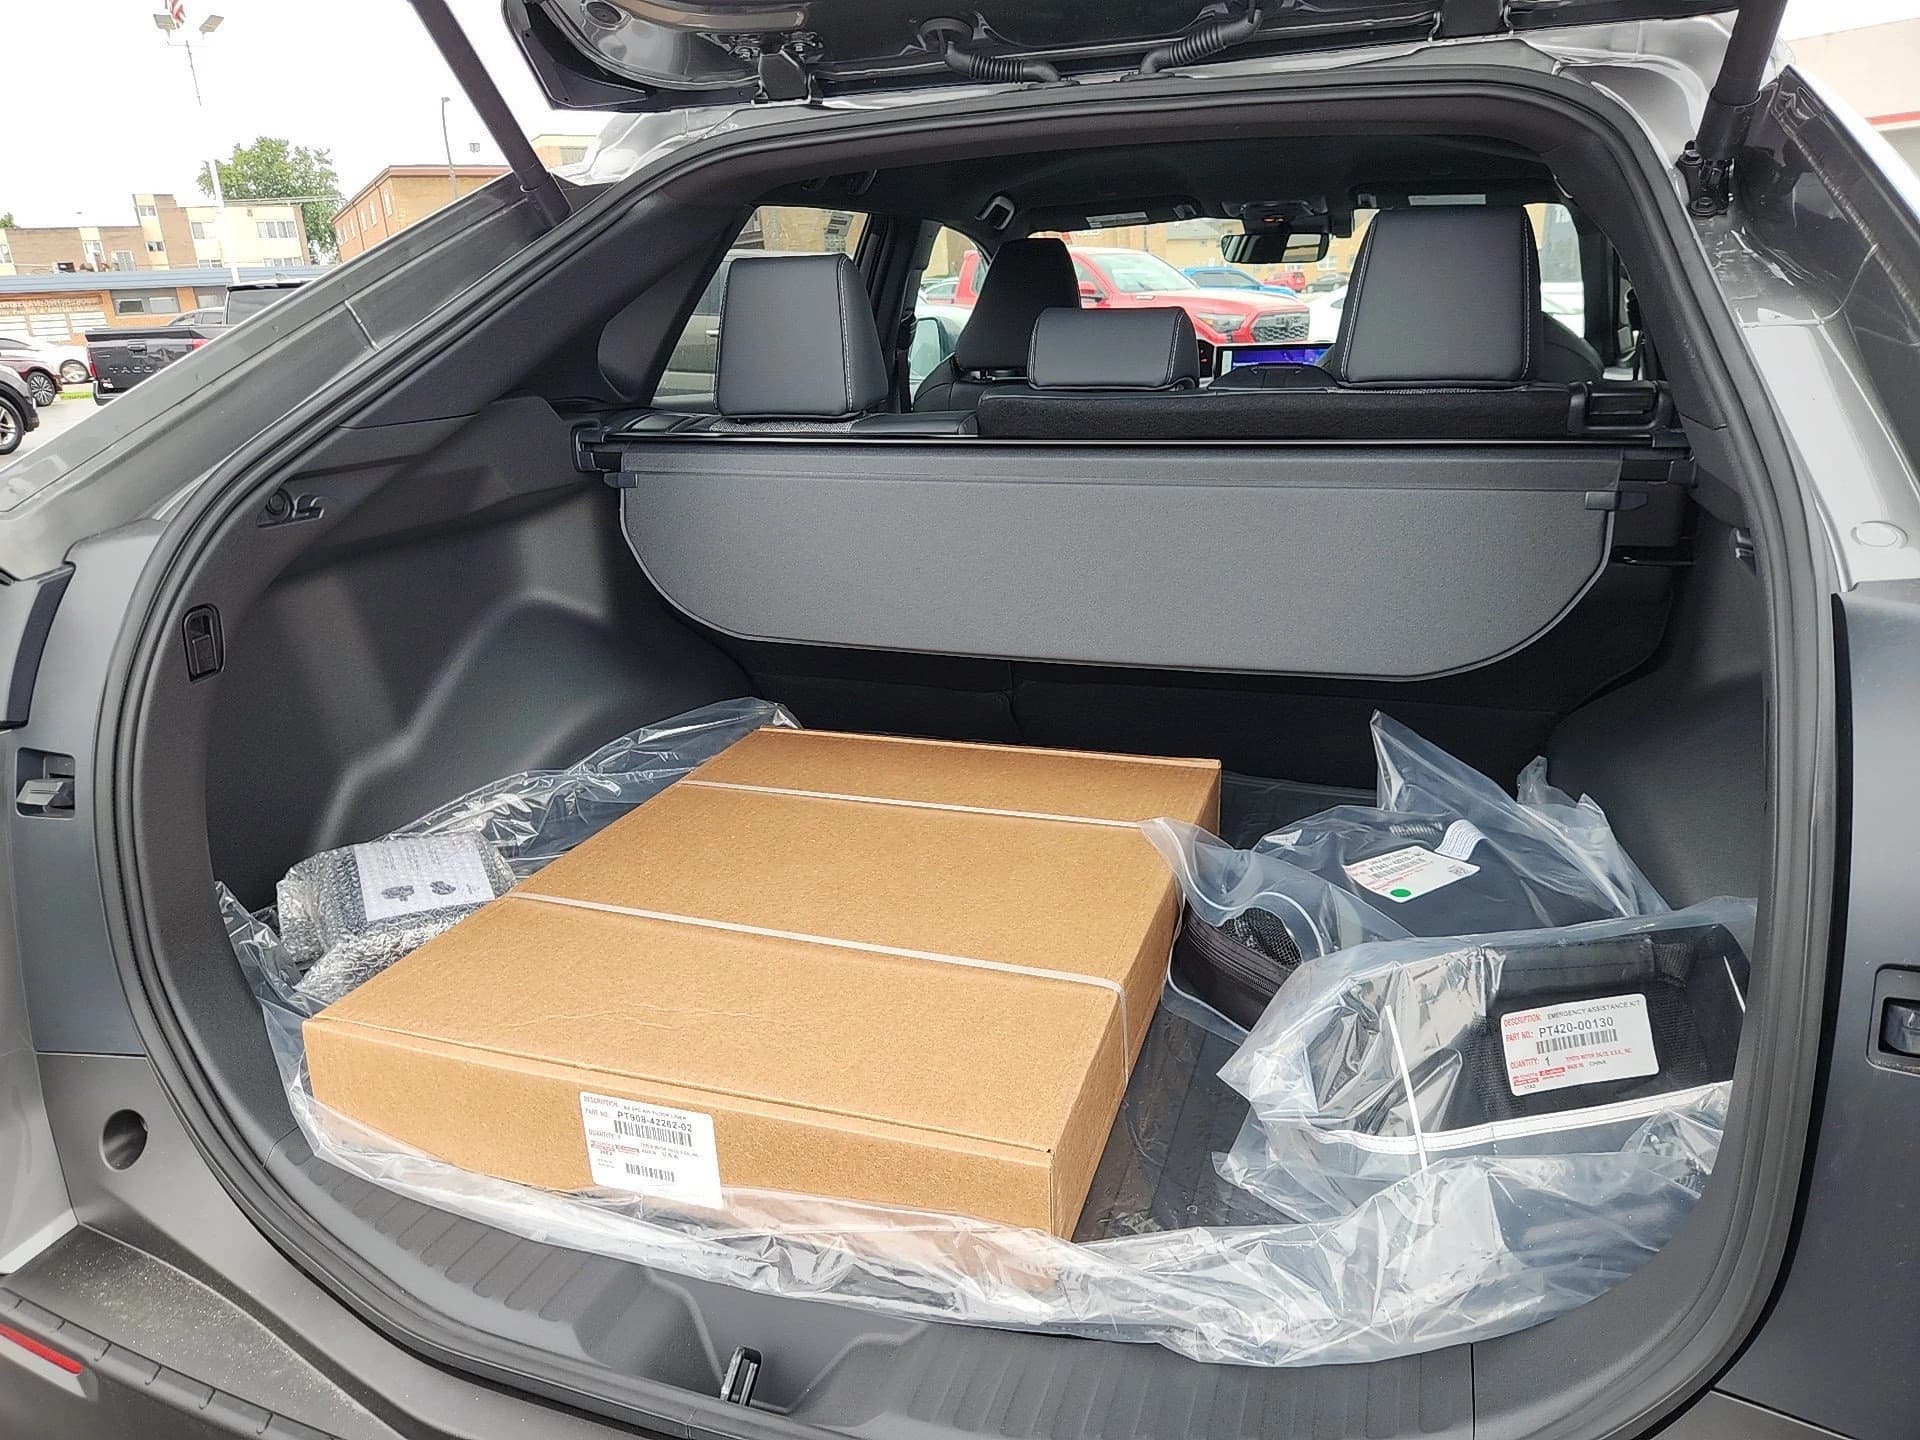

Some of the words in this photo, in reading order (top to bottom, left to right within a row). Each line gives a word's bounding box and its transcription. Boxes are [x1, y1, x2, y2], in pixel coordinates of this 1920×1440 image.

[1547, 1008, 1587, 1020] EMERGENCY
[1587, 1003, 1628, 1014] ASSISTANCE
[1629, 1000, 1641, 1008] KIT
[1505, 1032, 1520, 1042] PART
[1538, 1016, 1614, 1038] PT420-00130
[1544, 1056, 1551, 1067] 1
[617, 1111, 693, 1132] PT908-42262-02
